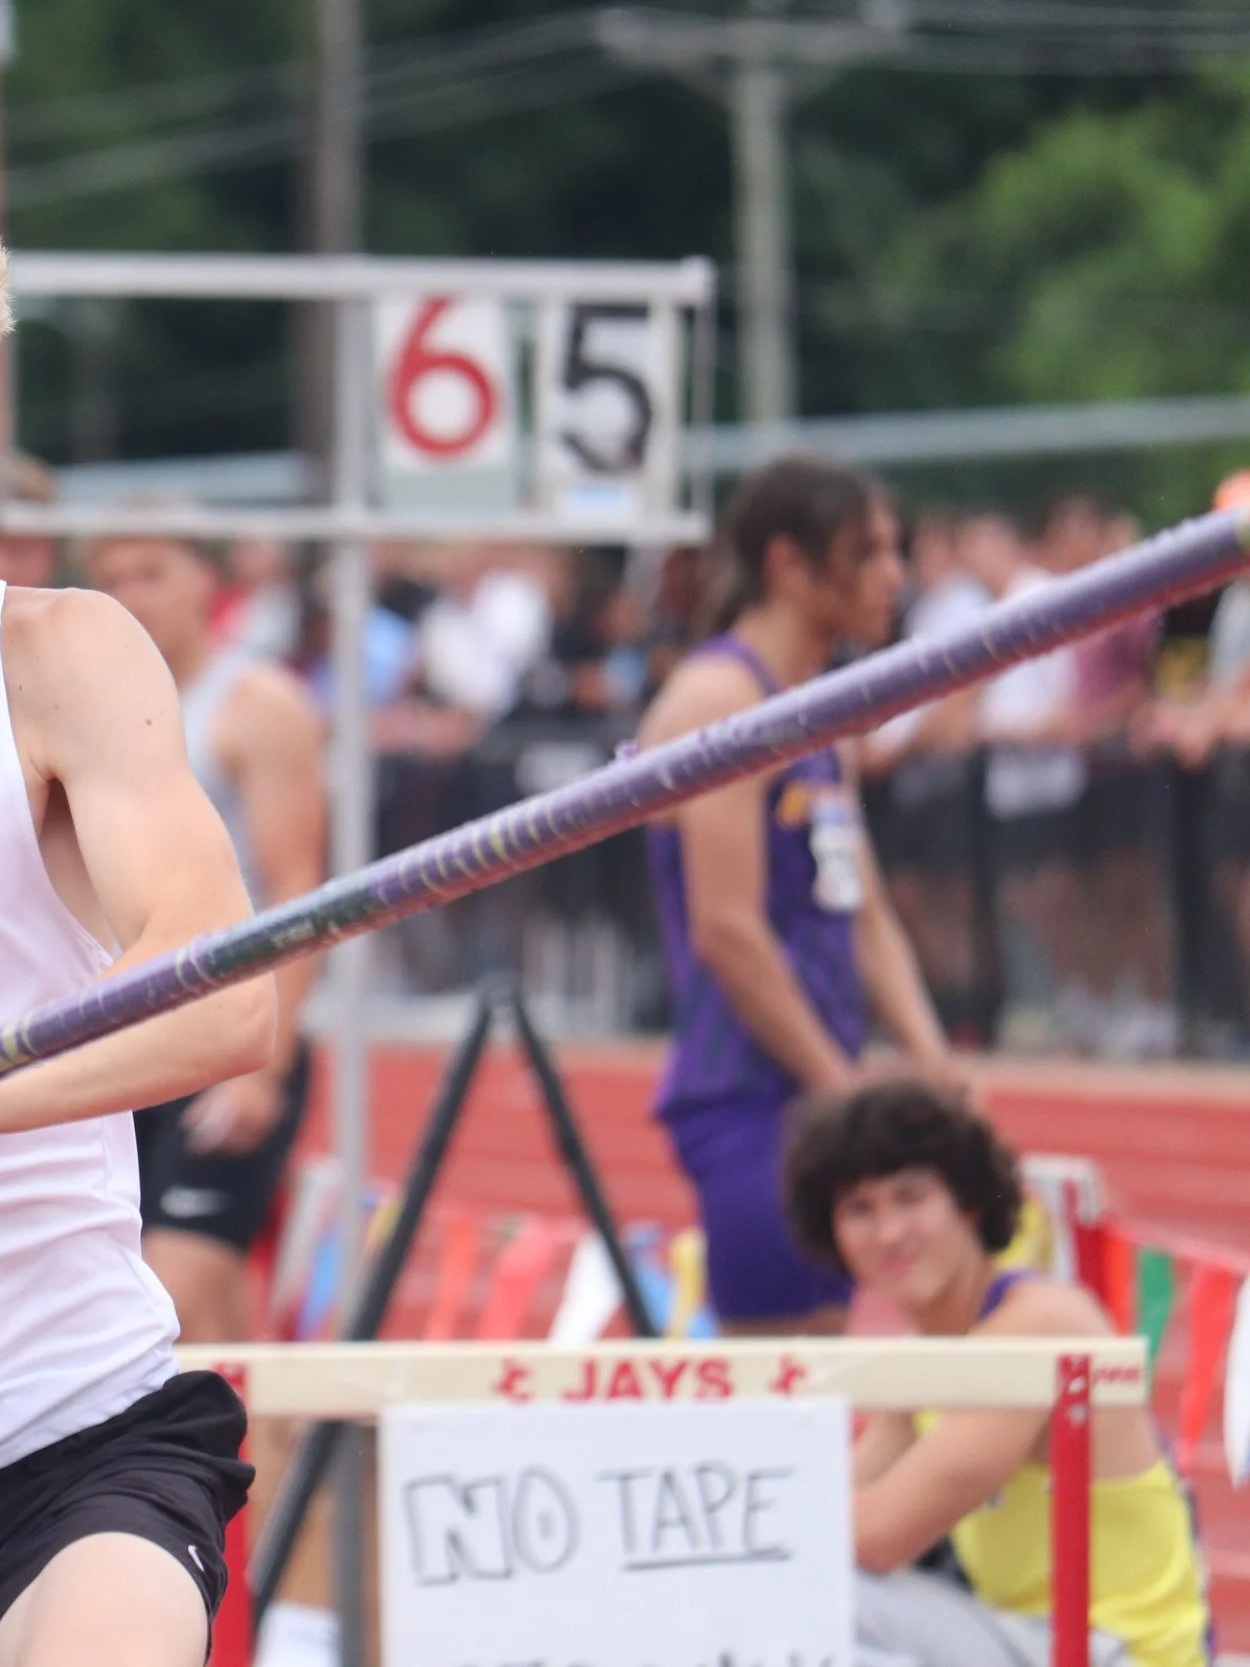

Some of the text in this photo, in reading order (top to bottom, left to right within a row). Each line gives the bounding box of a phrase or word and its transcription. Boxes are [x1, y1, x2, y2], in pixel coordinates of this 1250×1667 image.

[386, 296, 654, 477] 6 5
[562, 1357, 732, 1402] JAYS
[402, 1461, 794, 1586] NO TAPE
